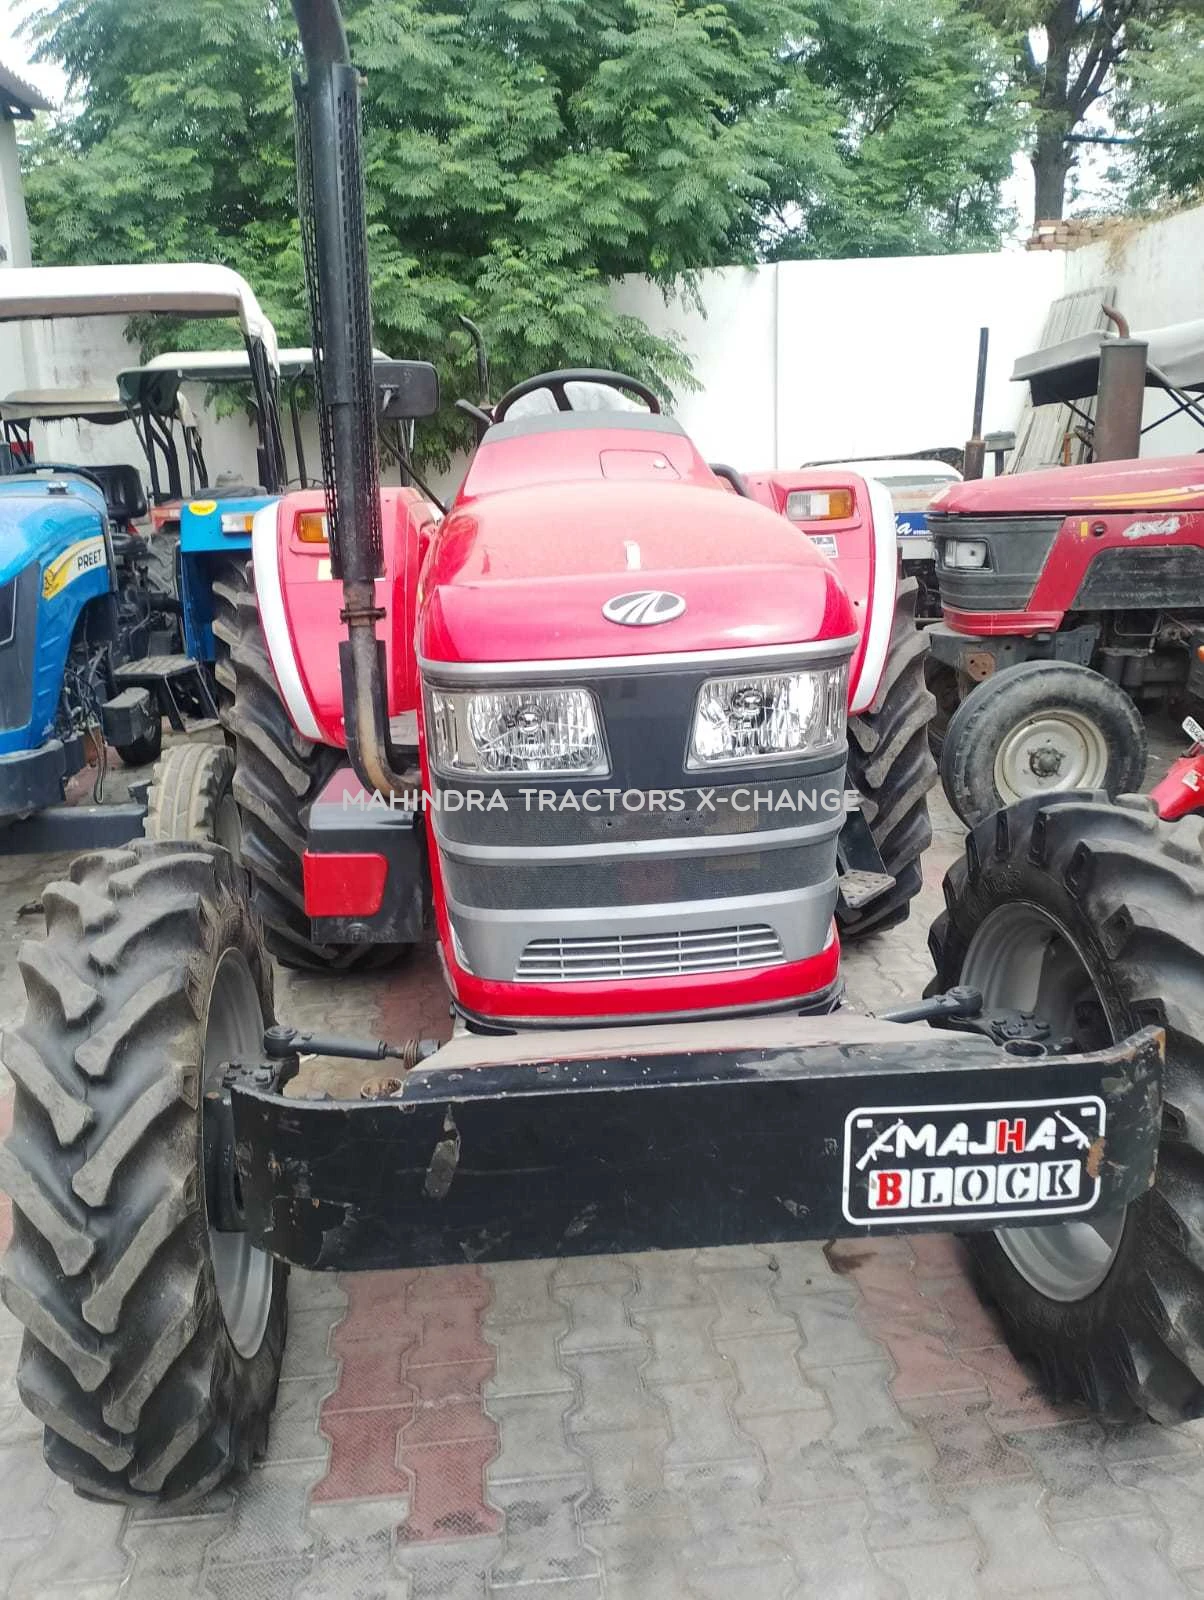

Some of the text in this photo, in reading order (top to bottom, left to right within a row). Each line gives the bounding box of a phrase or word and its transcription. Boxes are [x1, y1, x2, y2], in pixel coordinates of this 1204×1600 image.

[77, 549, 102, 570] PREET
[895, 1117, 1057, 1158] MAJHA
[876, 1164, 1074, 1206] BLOCK
